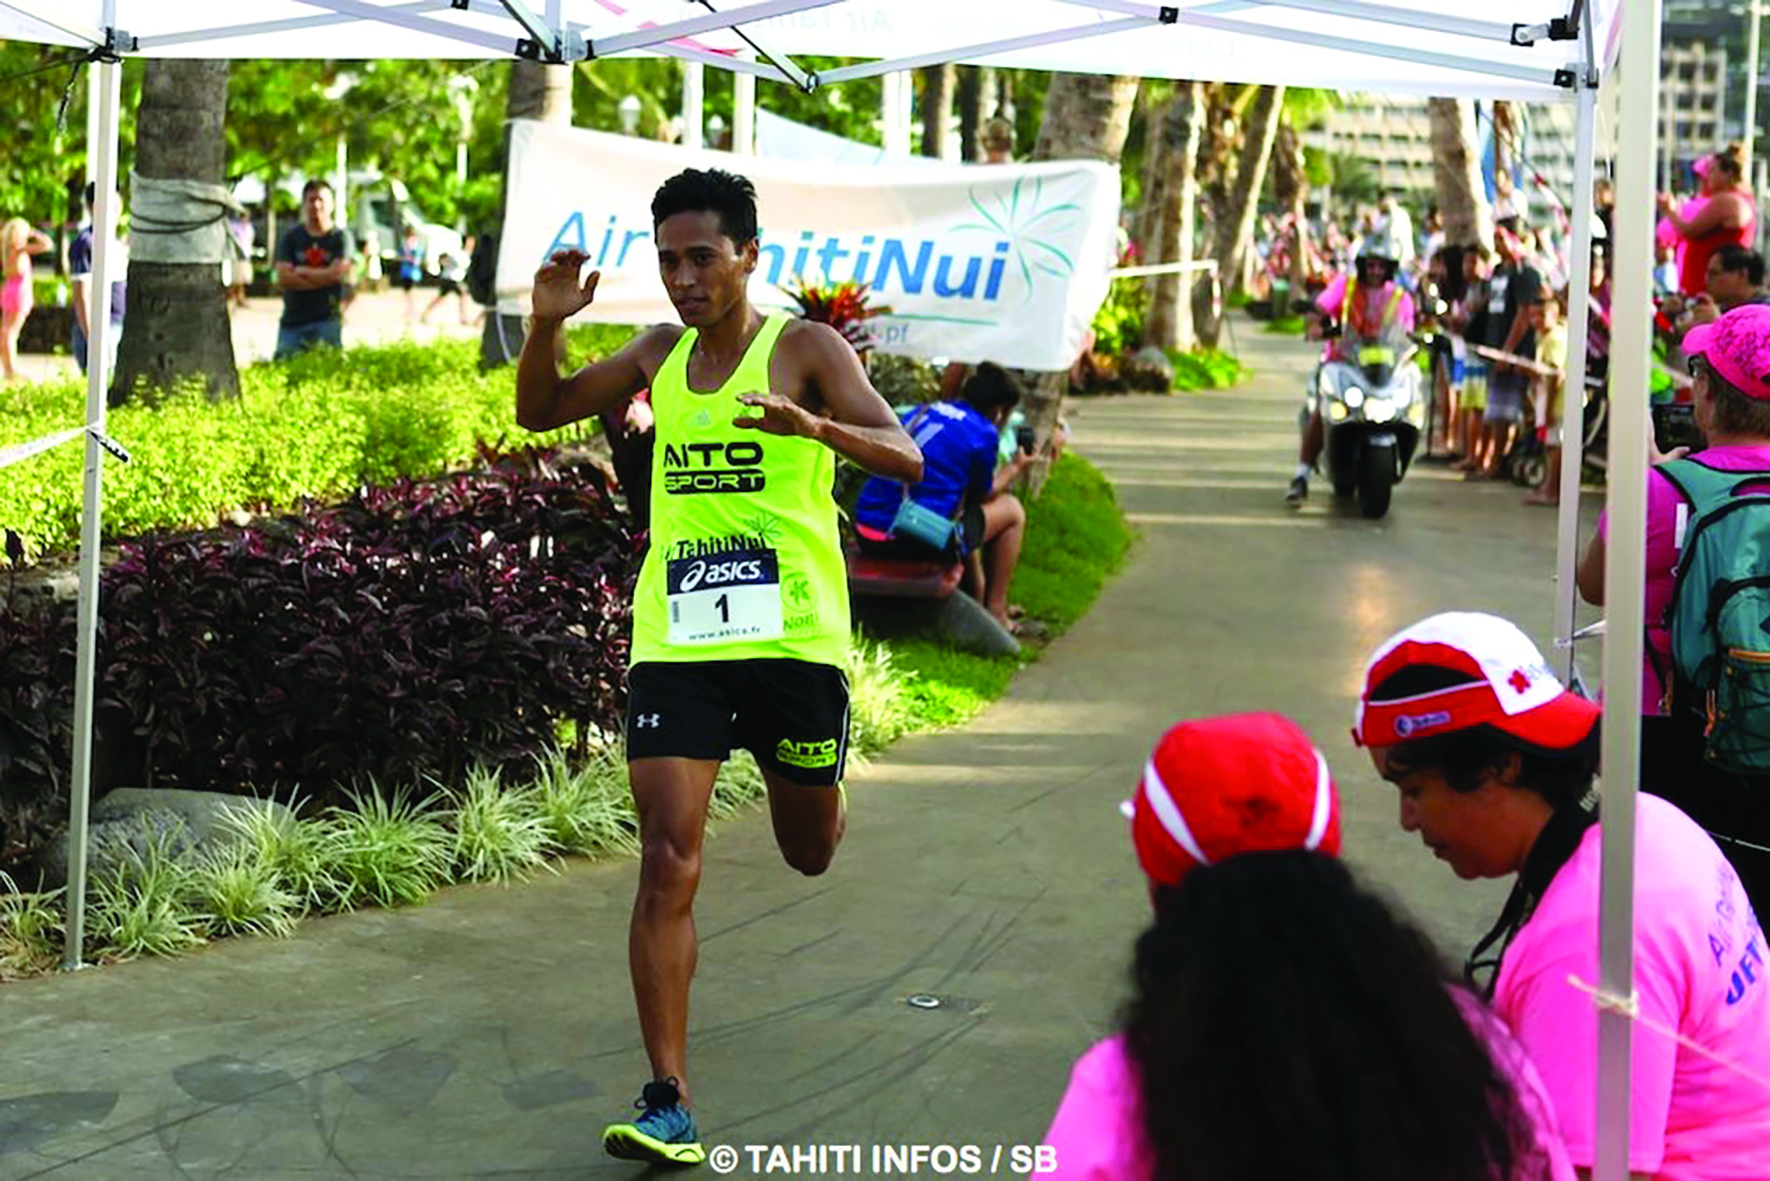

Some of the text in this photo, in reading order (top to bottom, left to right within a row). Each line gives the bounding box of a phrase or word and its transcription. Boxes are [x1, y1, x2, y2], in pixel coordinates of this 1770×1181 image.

[543, 211, 1010, 300] Air hitiNui
[664, 441, 764, 468] AITO
[665, 472, 764, 492] SPORT
[715, 594, 729, 623] 1
